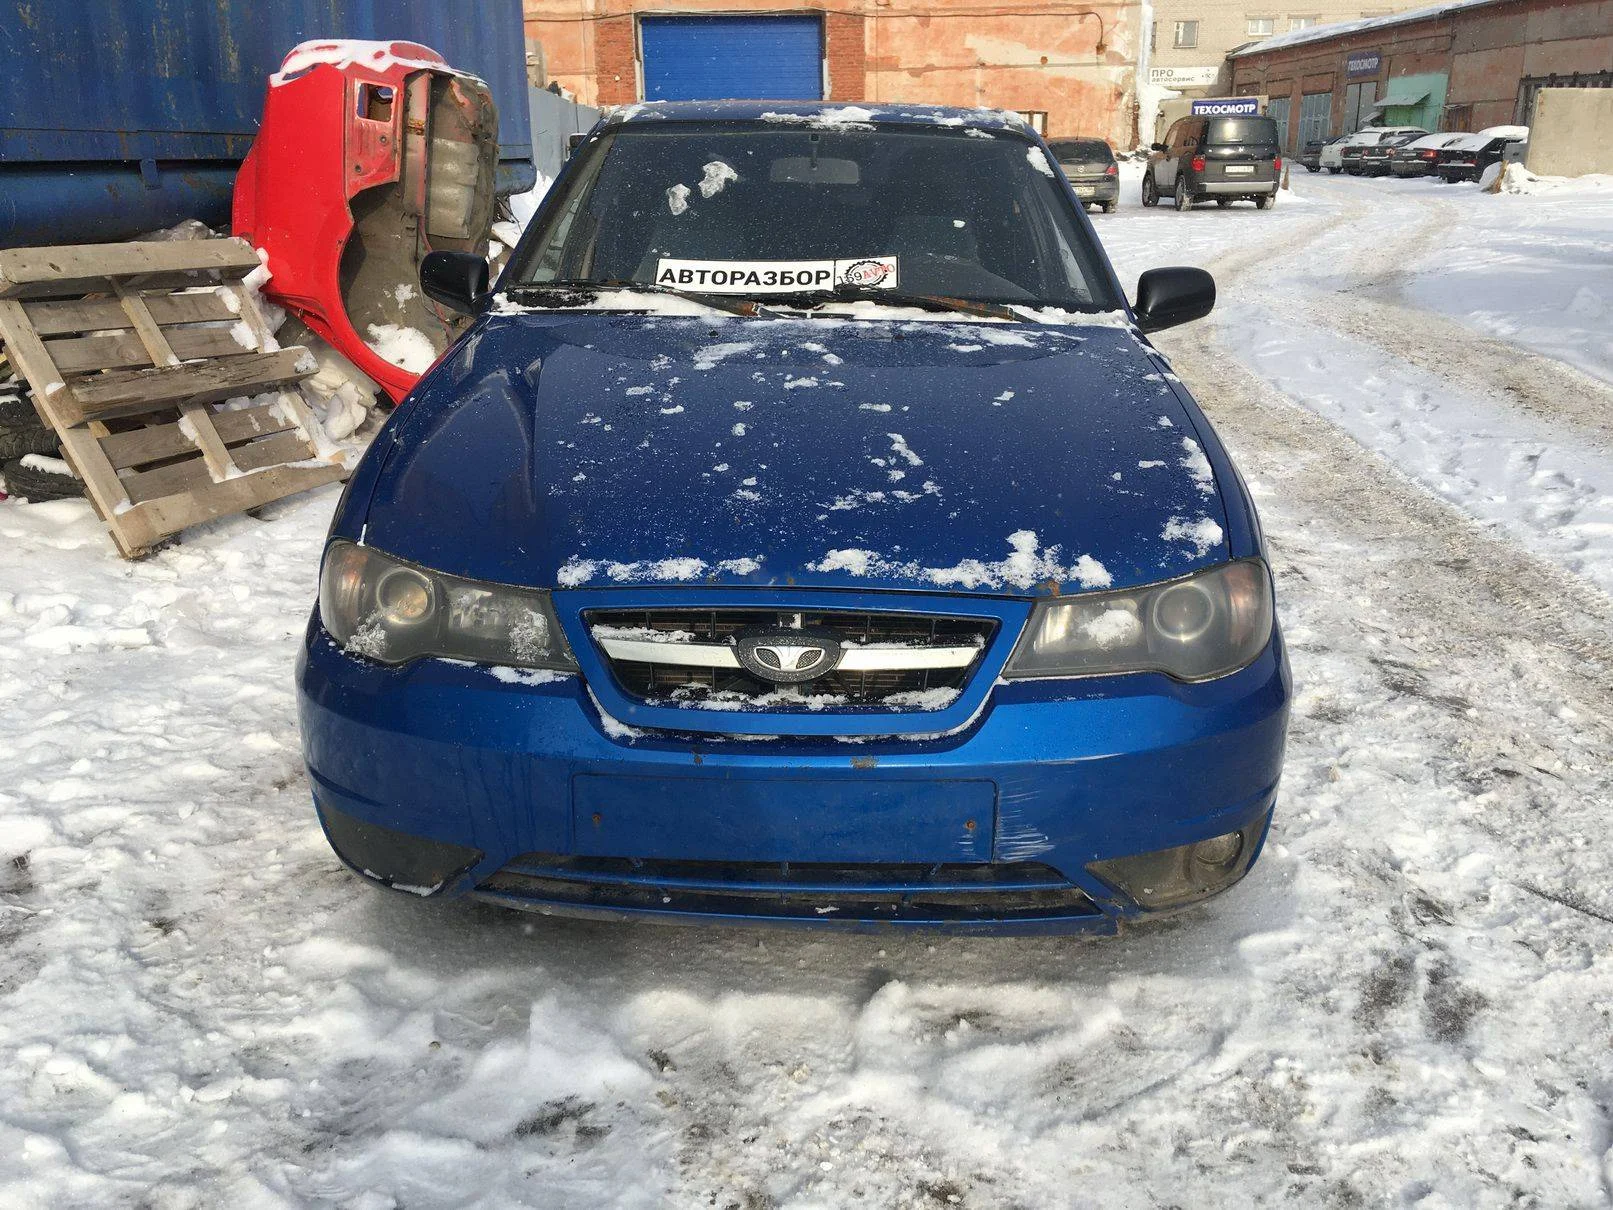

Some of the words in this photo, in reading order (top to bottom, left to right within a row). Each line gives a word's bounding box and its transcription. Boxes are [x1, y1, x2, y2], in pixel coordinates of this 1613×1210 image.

[1151, 69, 1174, 77] ПРО
[1193, 103, 1256, 115] ТЕХОСМОТР
[658, 268, 831, 286] АВТОРАЗБОР
